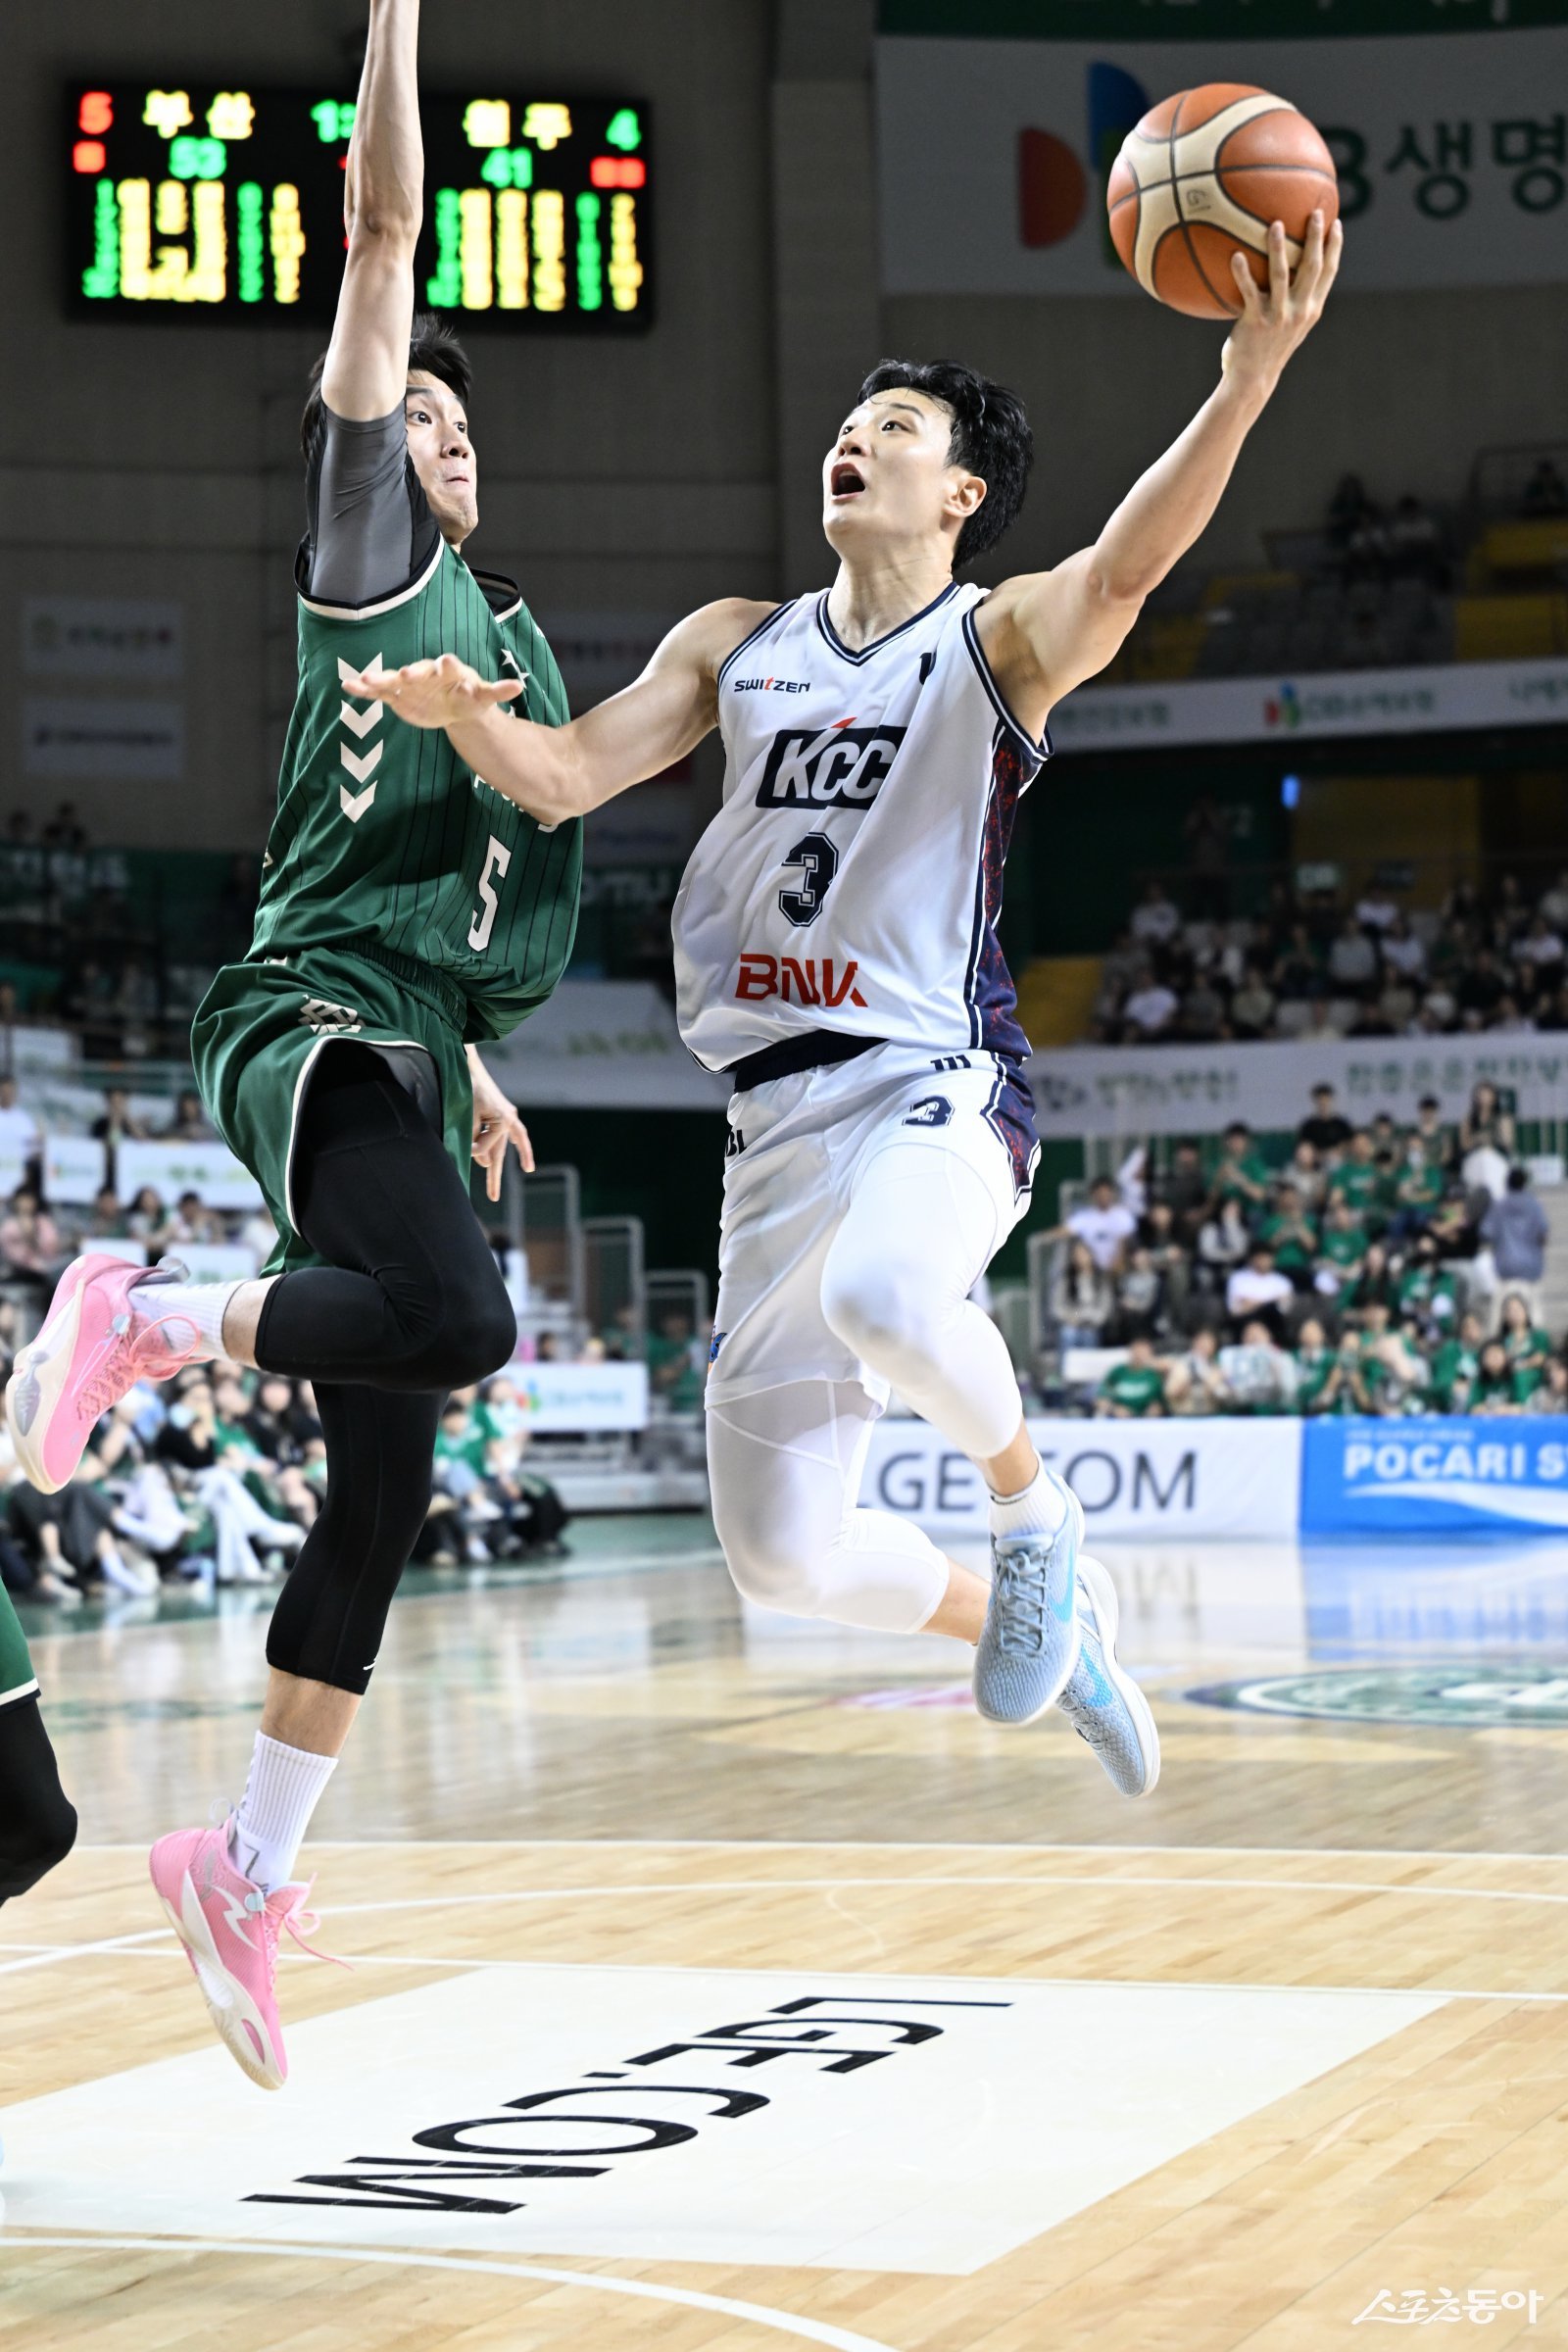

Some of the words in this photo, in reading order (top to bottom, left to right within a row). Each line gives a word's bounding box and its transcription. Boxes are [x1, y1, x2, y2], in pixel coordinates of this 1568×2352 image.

[772, 717, 899, 802] KCC
[467, 834, 513, 953] 5
[778, 831, 840, 928] 3
[901, 1095, 956, 1127] 3
[1344, 1442, 1526, 1481] POCARI
[1536, 1442, 1568, 1481] S
[238, 1995, 1015, 2215] LGE.COM
